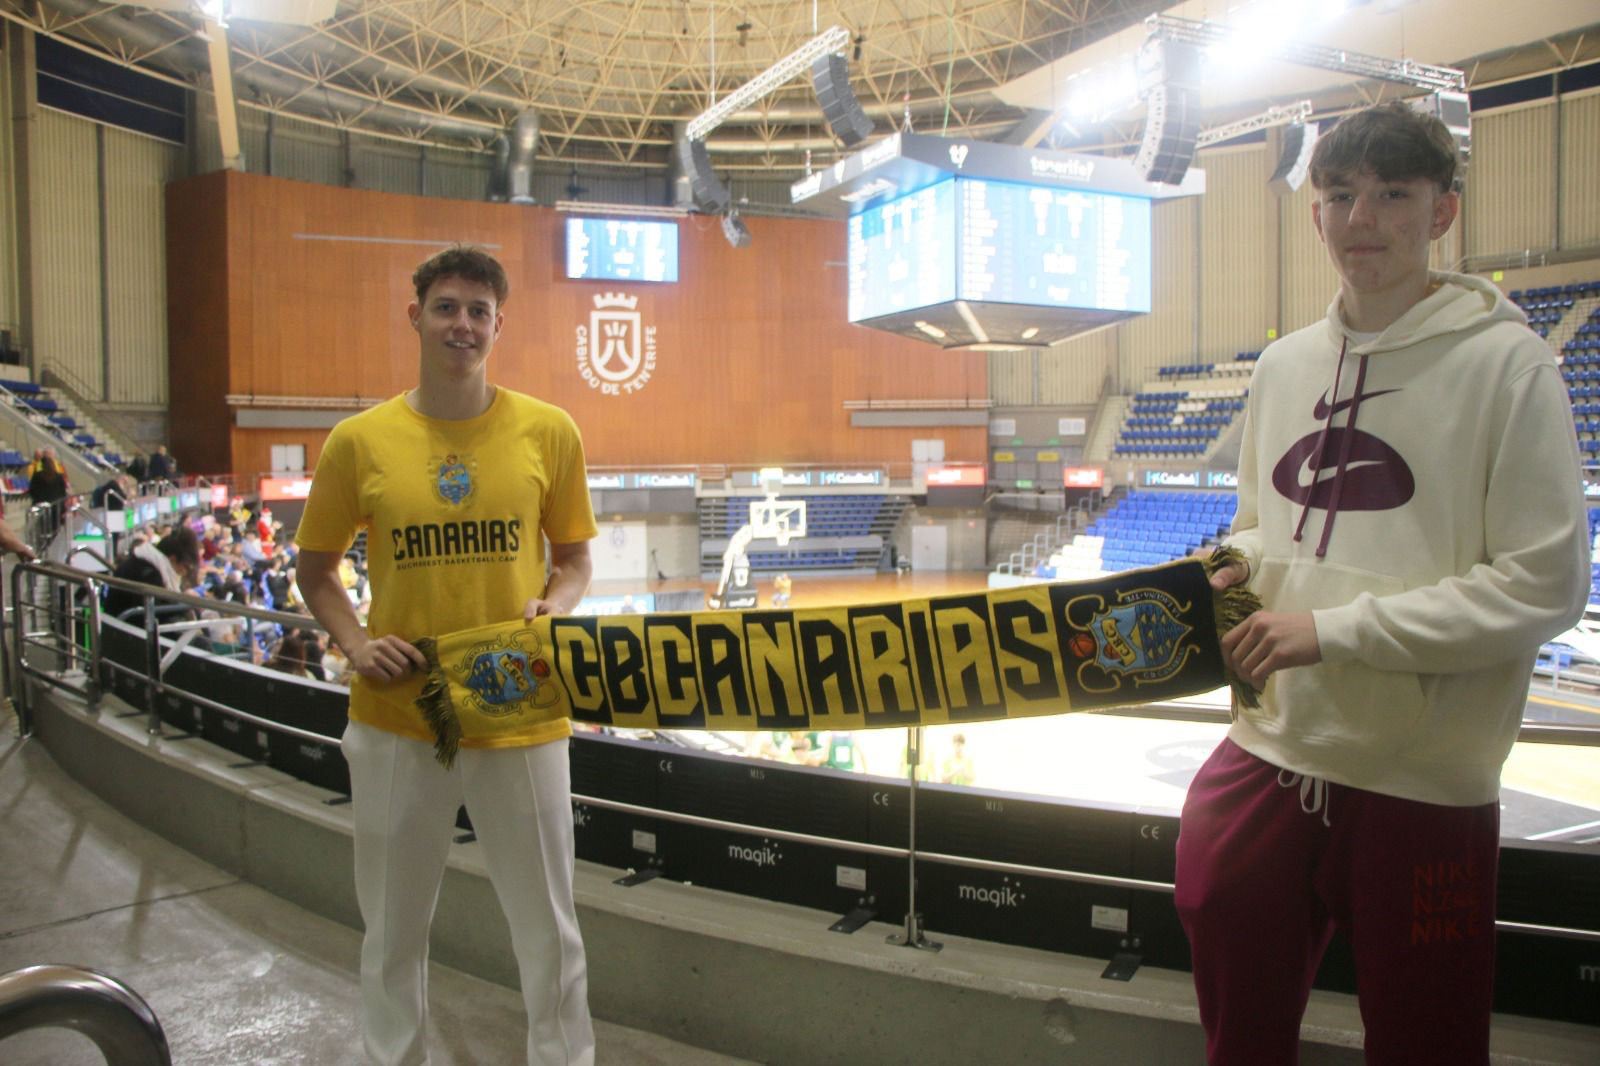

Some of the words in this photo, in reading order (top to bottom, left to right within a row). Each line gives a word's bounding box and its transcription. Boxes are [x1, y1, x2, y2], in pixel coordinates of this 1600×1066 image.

[576, 325, 601, 389] CABILDO
[601, 383, 620, 396] DE
[623, 325, 656, 395] TENERIFE
[391, 519, 521, 561] CANARIAS
[728, 843, 776, 867] magik
[958, 882, 1017, 908] magik
